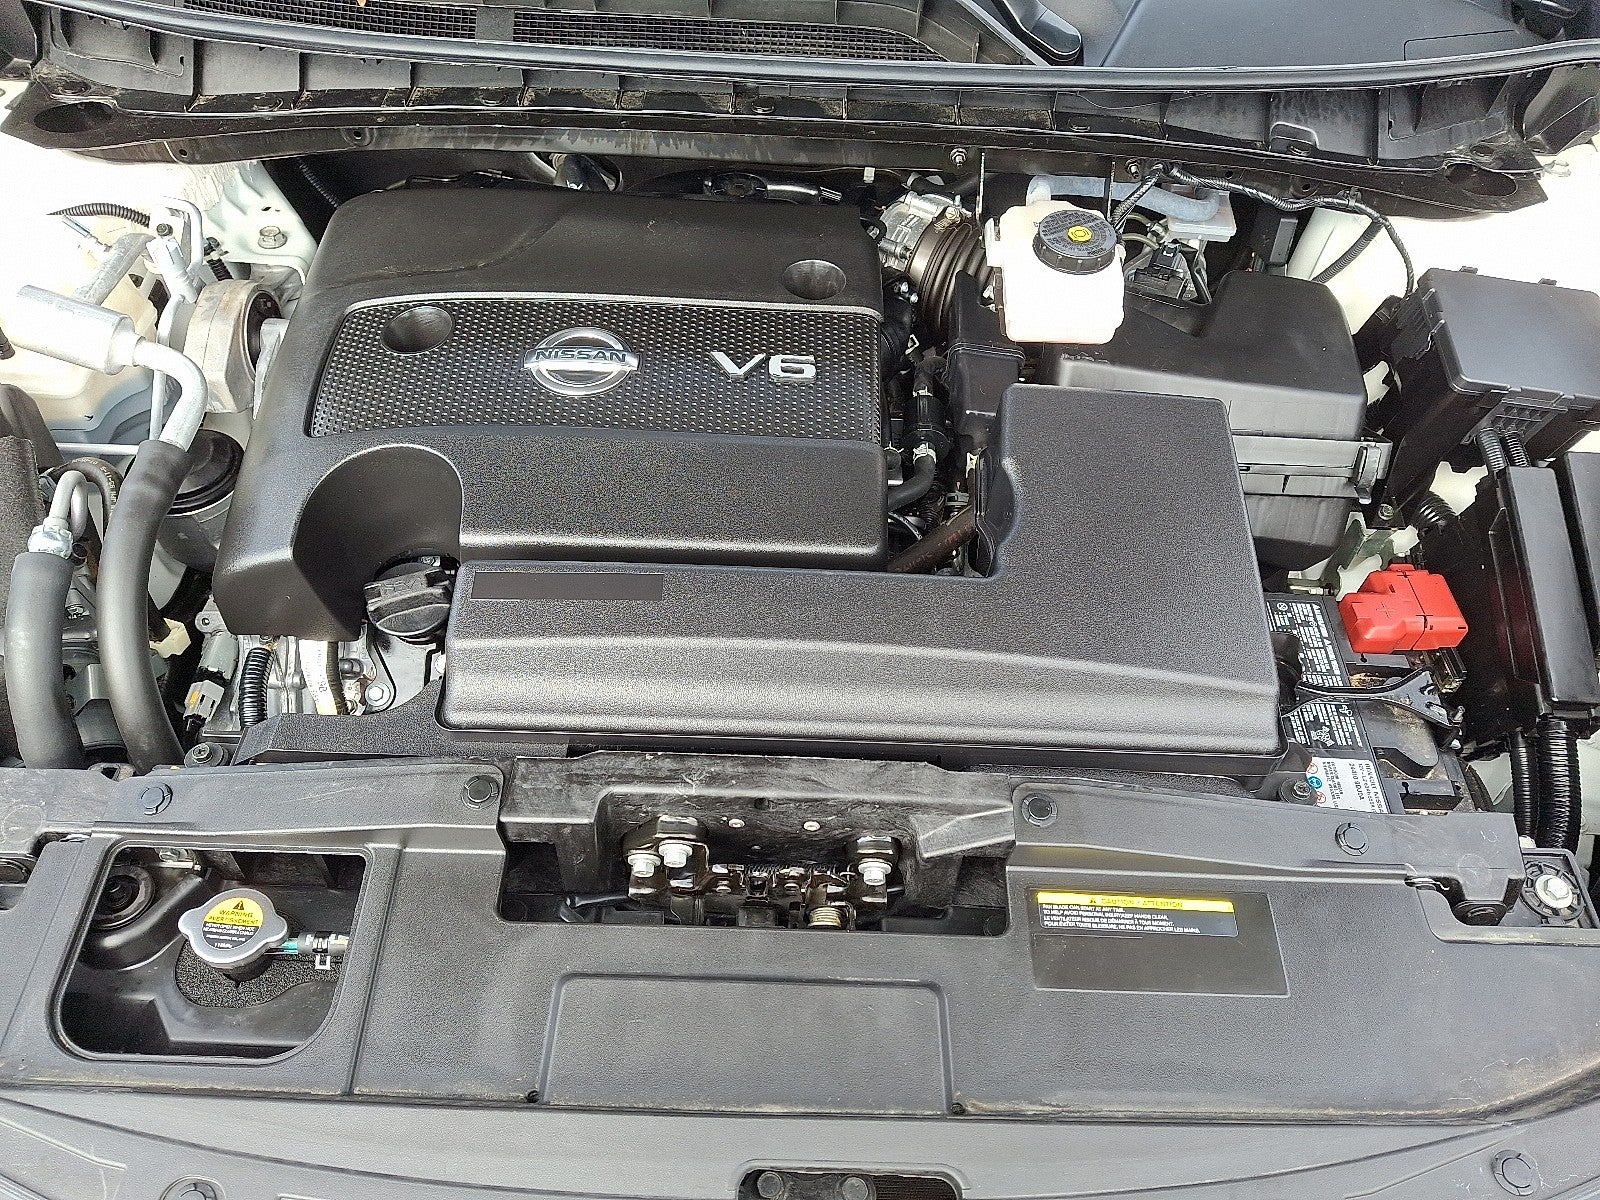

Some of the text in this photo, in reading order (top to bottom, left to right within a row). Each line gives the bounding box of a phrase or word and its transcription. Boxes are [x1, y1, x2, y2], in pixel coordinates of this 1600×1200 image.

[535, 349, 627, 362] NISSAN
[710, 351, 816, 382] V6
[1143, 900, 1183, 908] ATTENTION
[220, 910, 253, 918] WARNING
